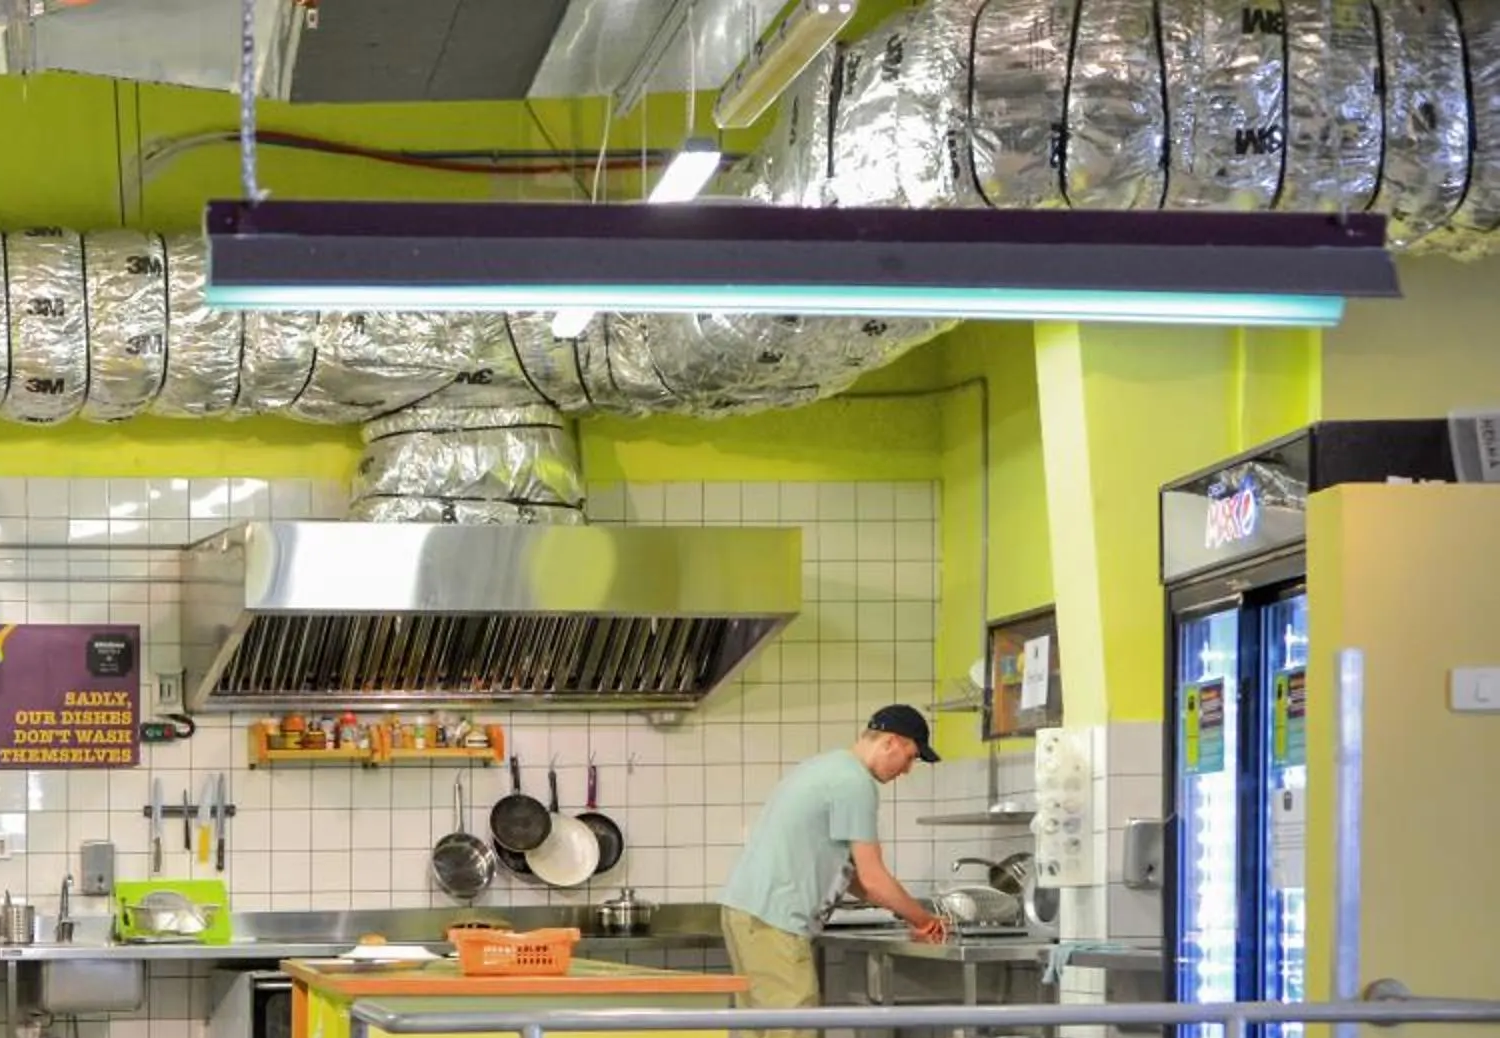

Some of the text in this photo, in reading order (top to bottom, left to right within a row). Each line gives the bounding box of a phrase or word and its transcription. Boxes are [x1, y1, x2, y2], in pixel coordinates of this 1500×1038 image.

[126, 255, 162, 277] 3M
[27, 298, 64, 317] 3M
[126, 333, 162, 355] 3M
[25, 378, 64, 395] 3M
[65, 691, 132, 708] SADLY,
[15, 711, 132, 725] OUR DISHES
[14, 730, 132, 744] DON'T WASH
[0, 748, 132, 763] THEMSELVES
